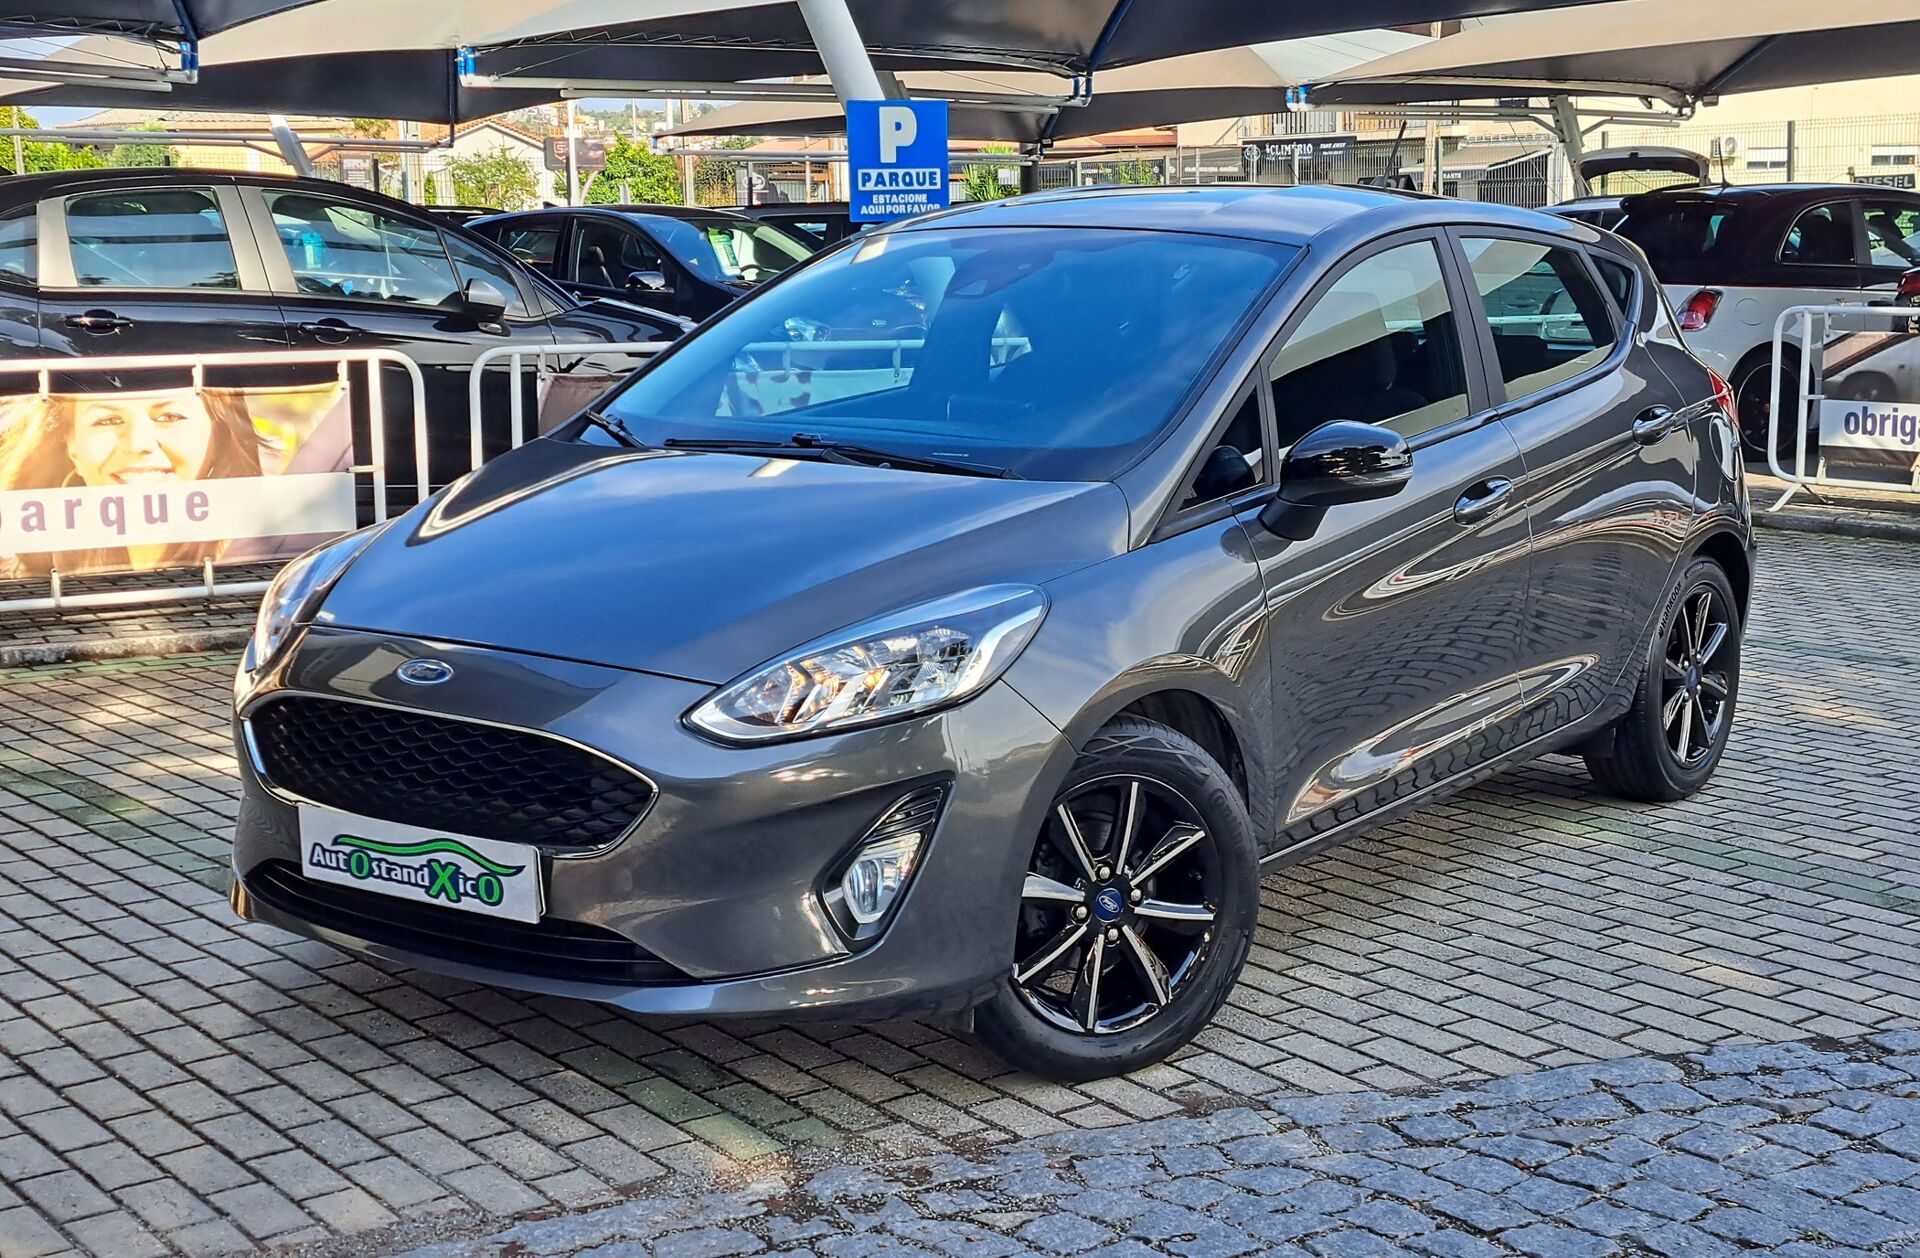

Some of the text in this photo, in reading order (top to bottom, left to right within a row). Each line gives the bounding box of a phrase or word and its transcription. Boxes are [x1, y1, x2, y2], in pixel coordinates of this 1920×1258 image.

[879, 106, 917, 163] P
[861, 171, 938, 187] PARQUE
[861, 205, 885, 215] AQUI
[886, 204, 906, 214] POR
[873, 193, 928, 204] ESTACIONE
[1844, 406, 1920, 445] obrig
[0, 490, 210, 535] arque
